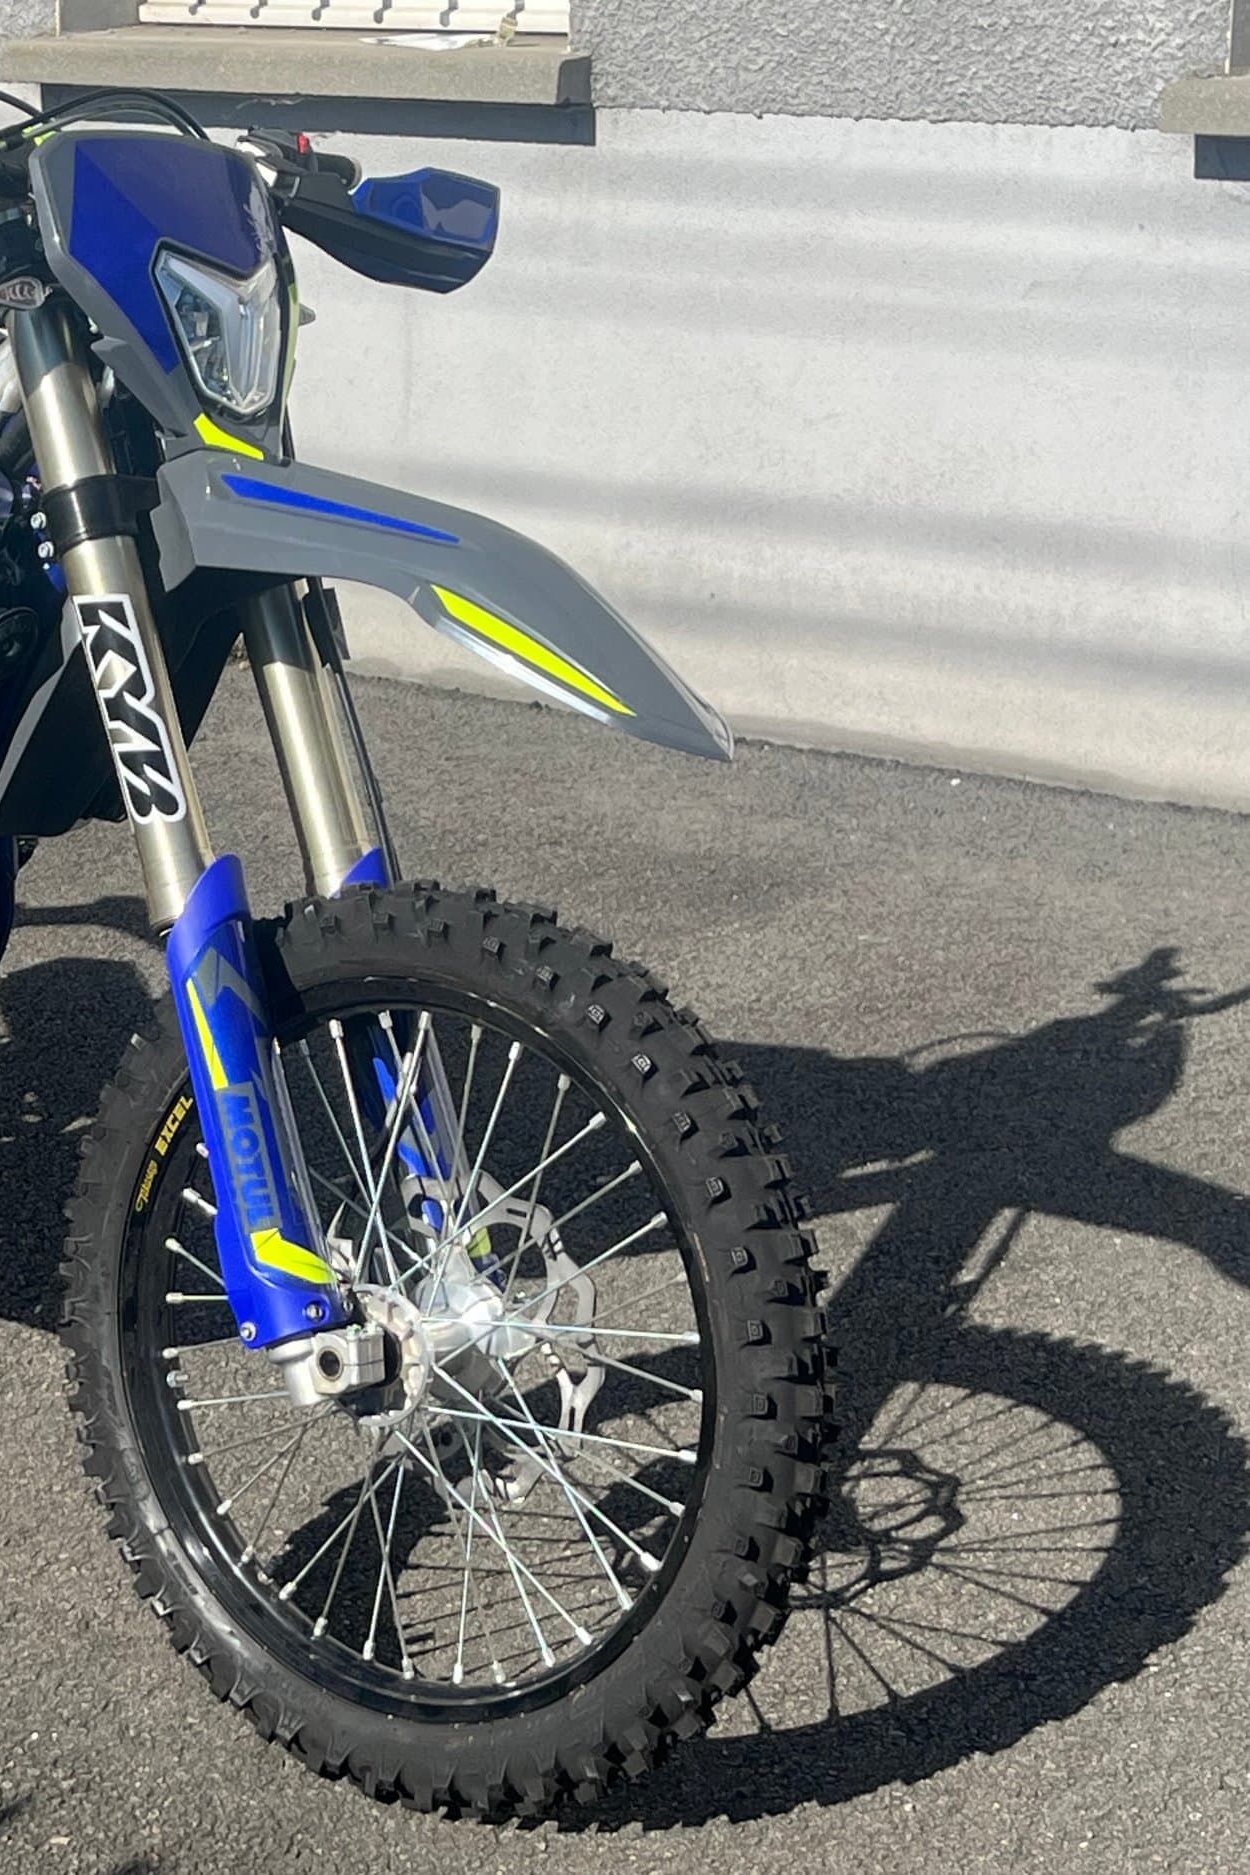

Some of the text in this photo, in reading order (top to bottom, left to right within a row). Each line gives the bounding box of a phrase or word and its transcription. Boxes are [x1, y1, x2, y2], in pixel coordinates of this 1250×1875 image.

[74, 597, 184, 822] KYB
[154, 1095, 193, 1157] EXCEL
[221, 1093, 275, 1226] MOTUL
